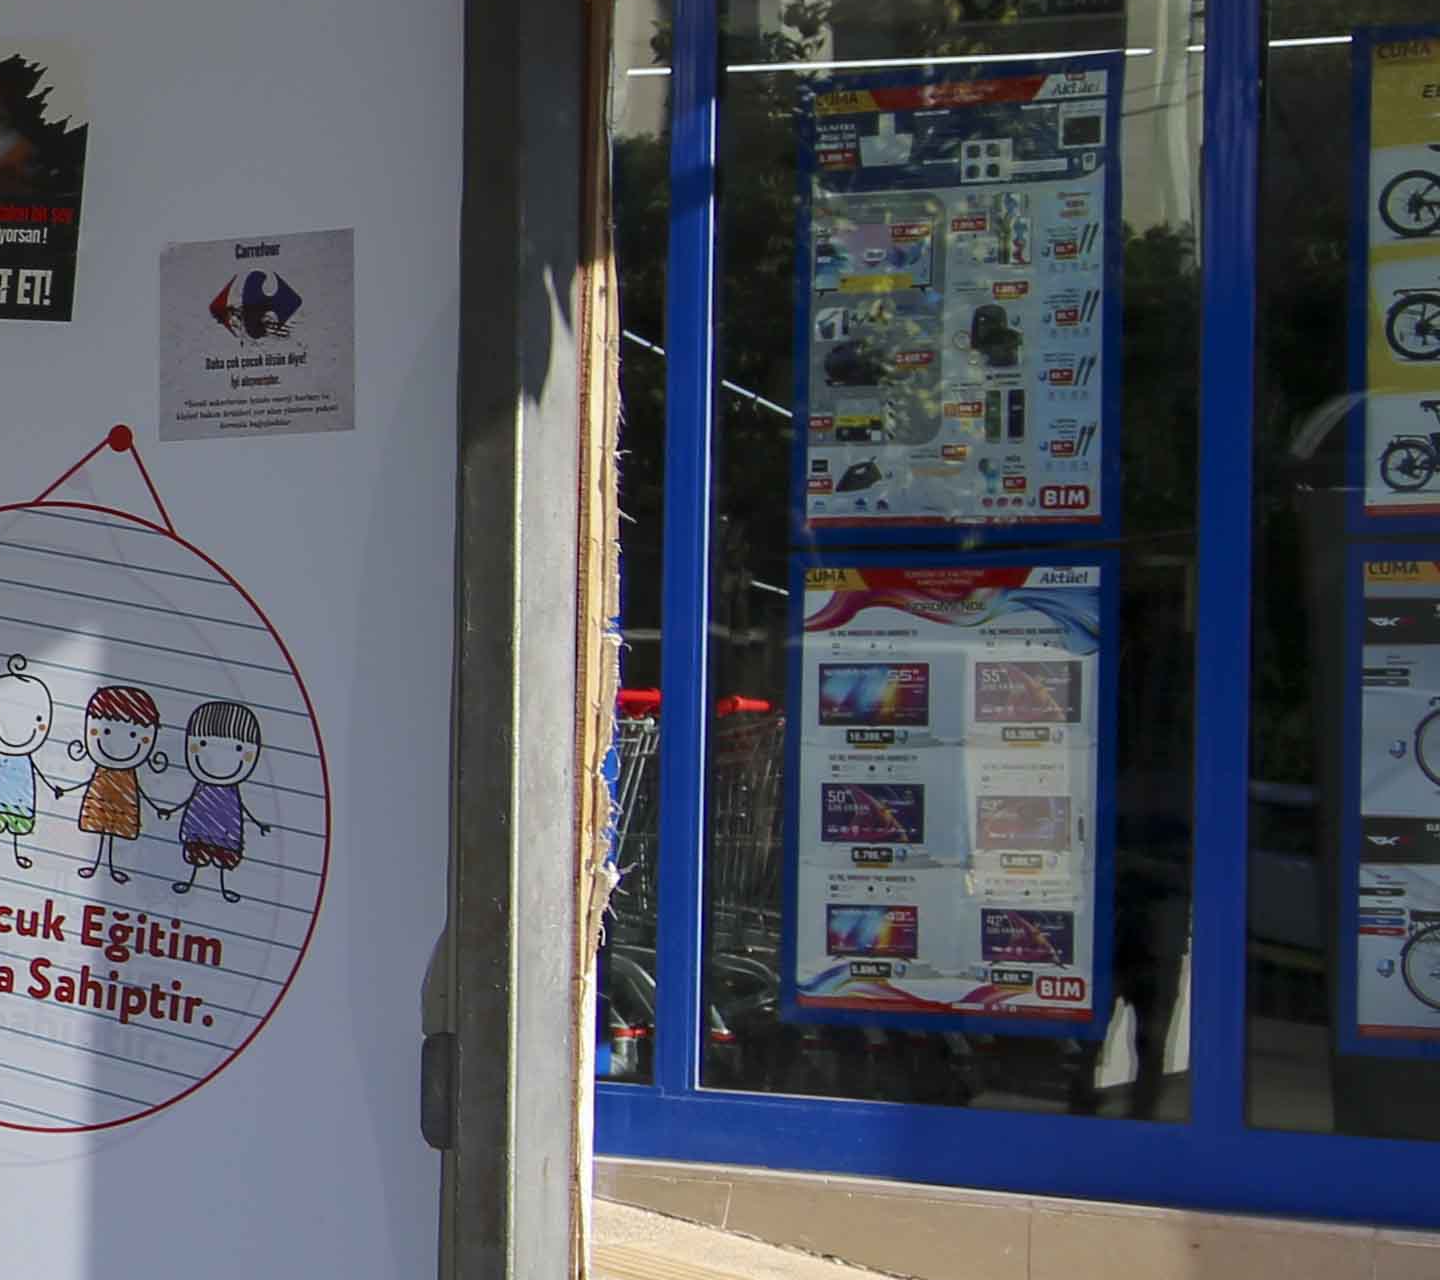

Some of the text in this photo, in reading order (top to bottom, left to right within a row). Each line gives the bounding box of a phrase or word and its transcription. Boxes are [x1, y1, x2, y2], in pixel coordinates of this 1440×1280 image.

[235, 242, 280, 259] Carrefour
[17, 269, 53, 305] ET!
[81, 905, 222, 967] Eğitim
[27, 957, 214, 1027] Sahiptir.
